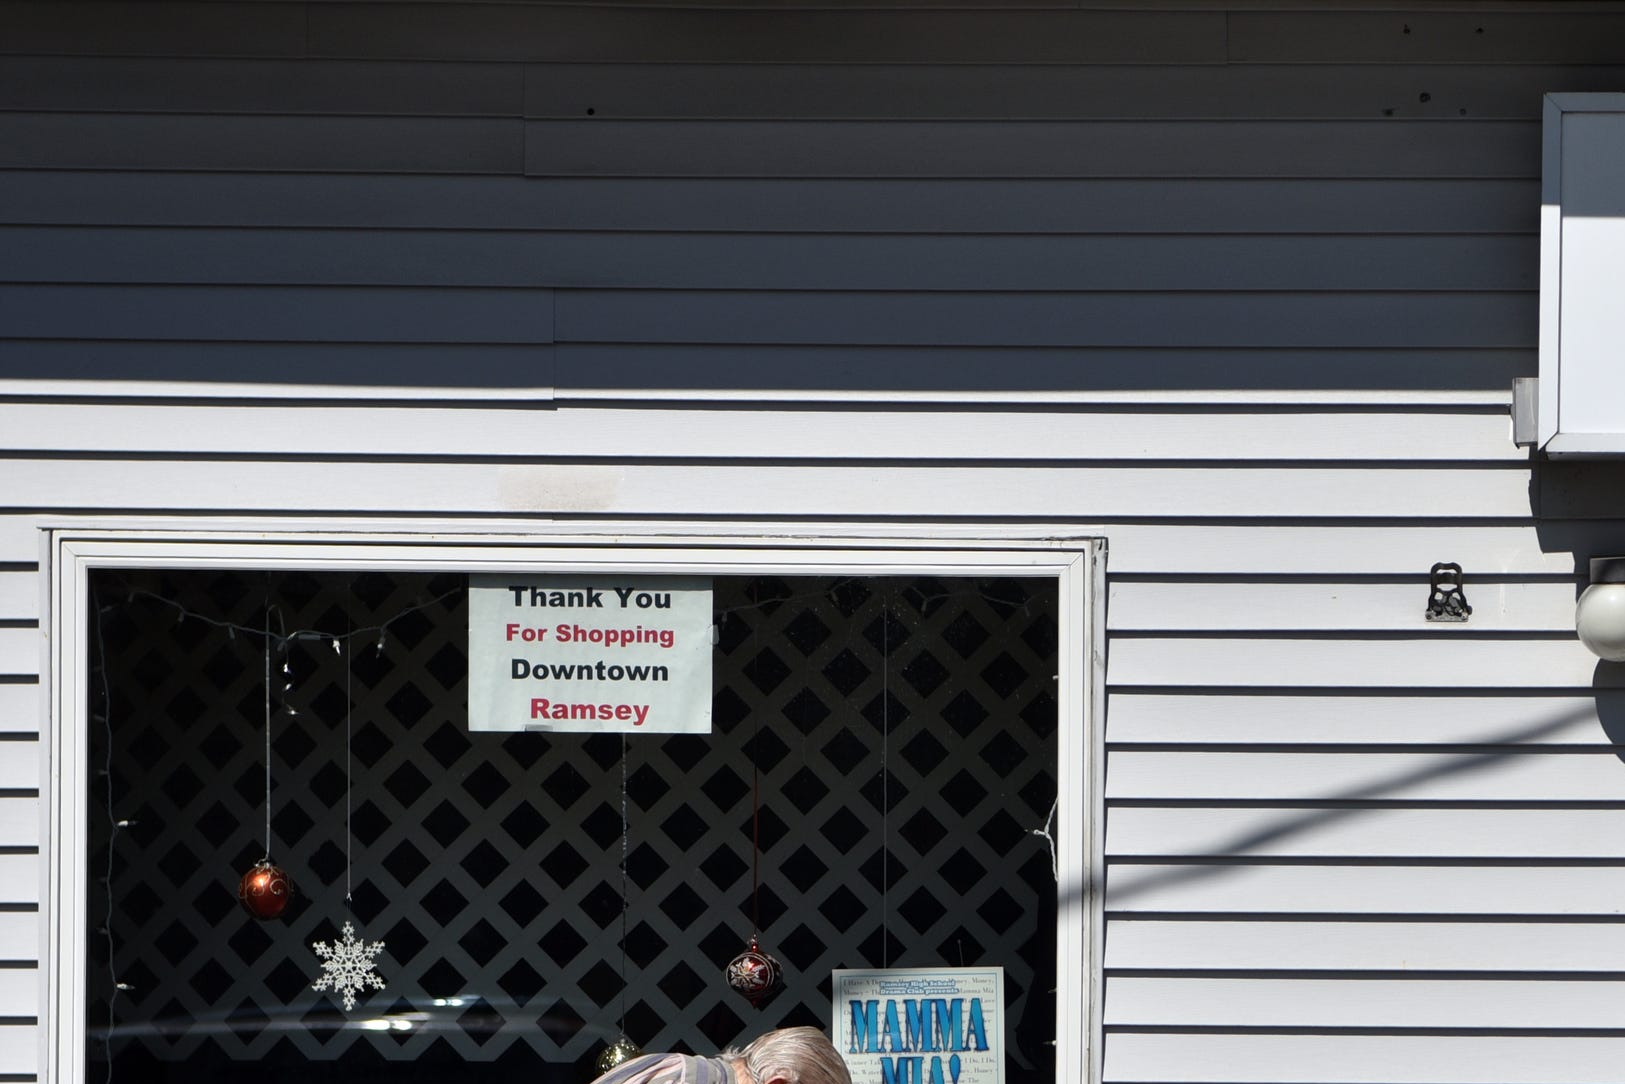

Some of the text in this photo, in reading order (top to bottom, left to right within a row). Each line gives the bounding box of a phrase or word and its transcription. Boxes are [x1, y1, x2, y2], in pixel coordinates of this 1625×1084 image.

[508, 586, 671, 608] Thank You
[506, 623, 674, 648] For Shopping
[511, 658, 669, 681] Downtown
[530, 698, 650, 726] Ramsey
[849, 998, 989, 1054] MAMMA
